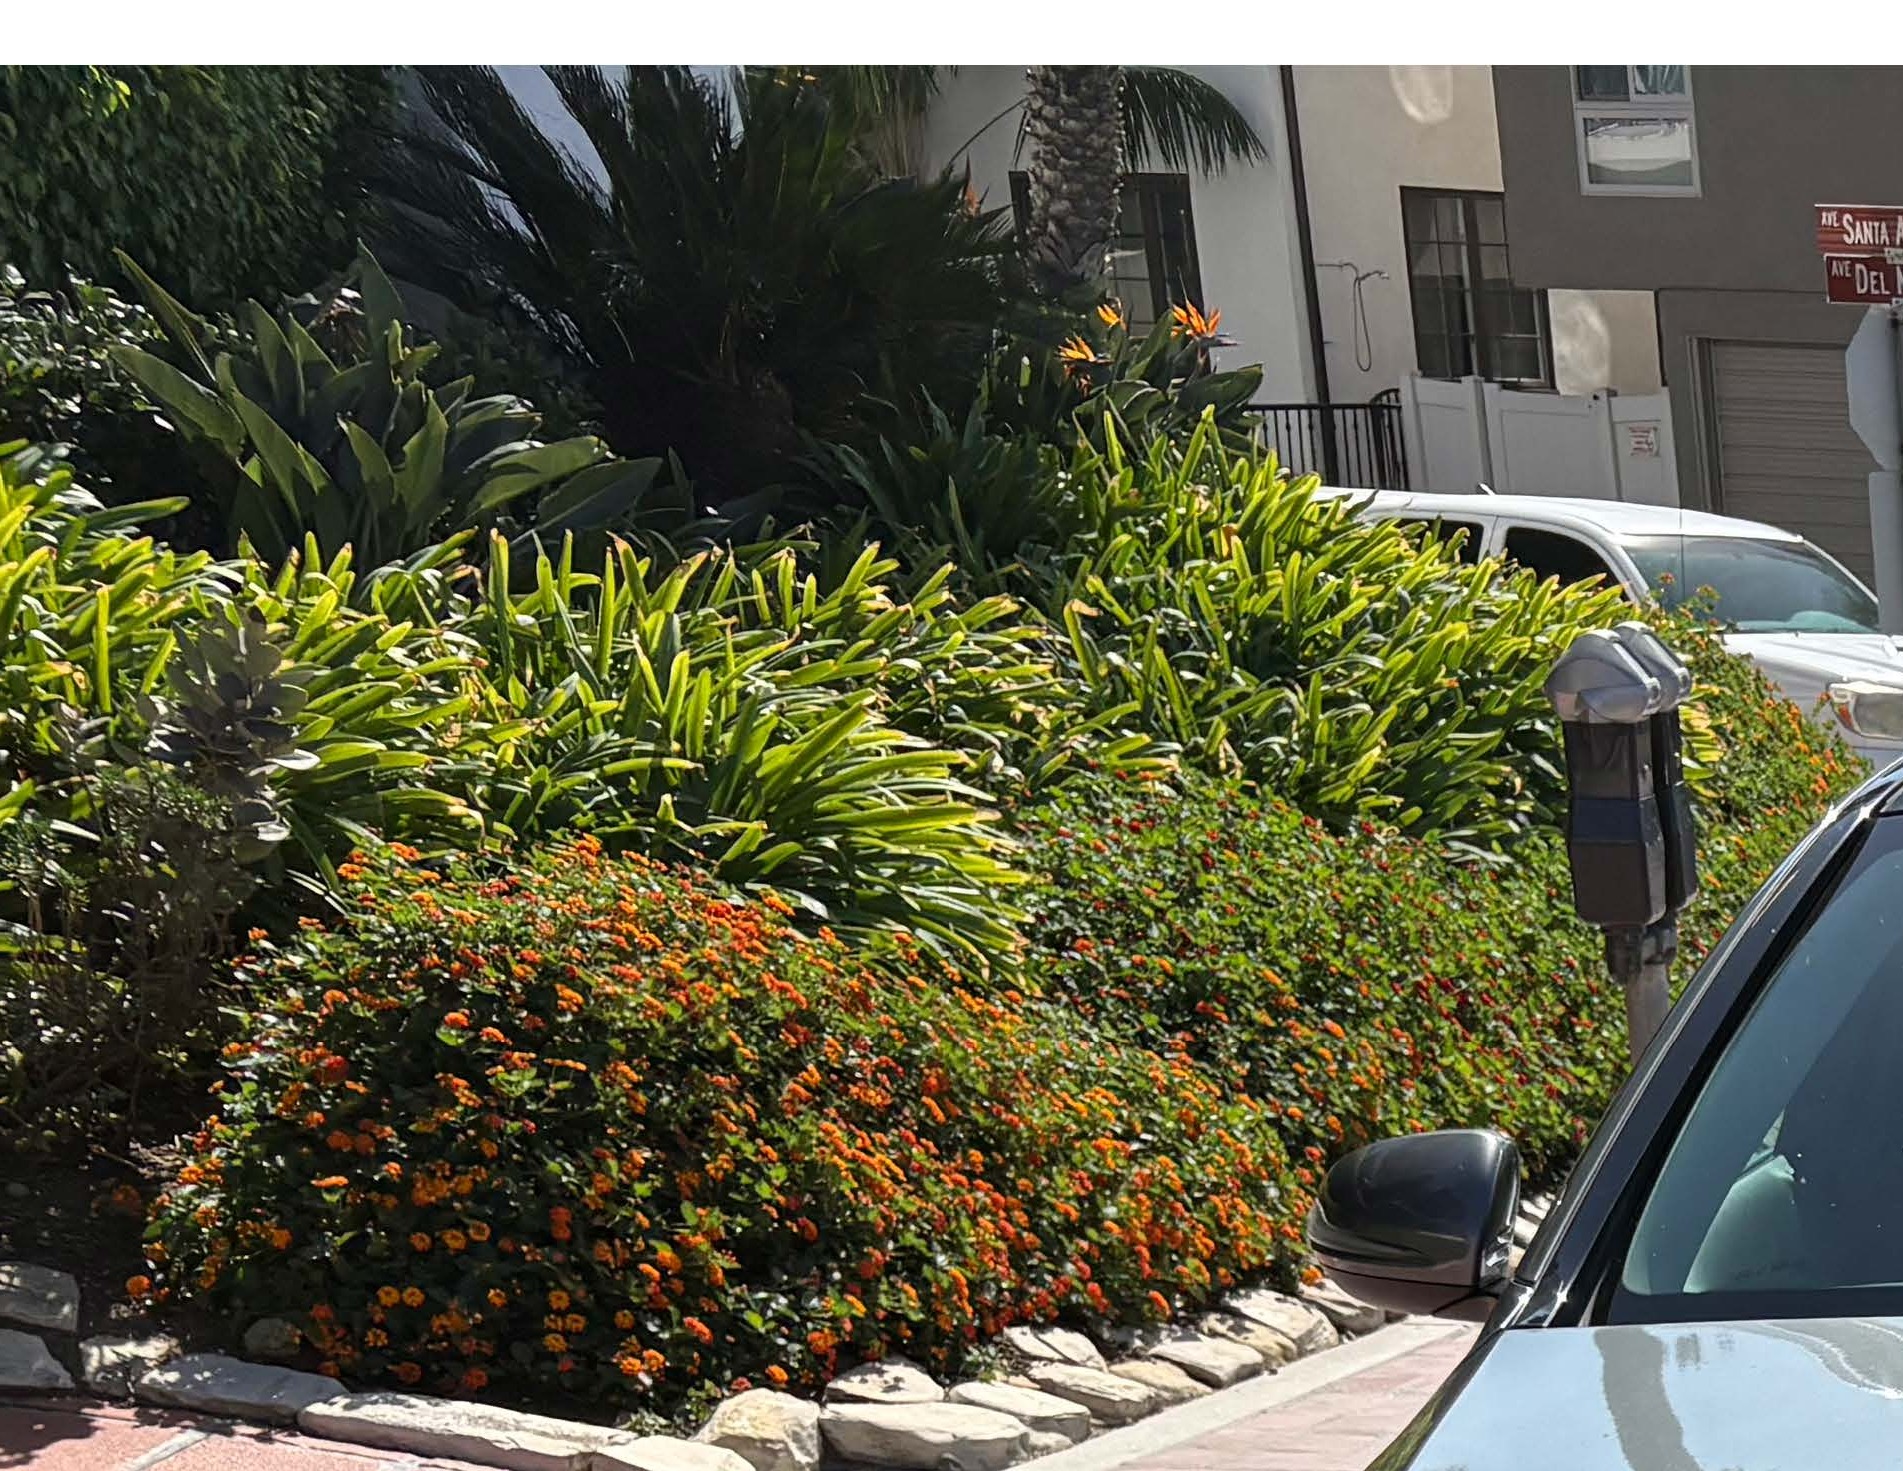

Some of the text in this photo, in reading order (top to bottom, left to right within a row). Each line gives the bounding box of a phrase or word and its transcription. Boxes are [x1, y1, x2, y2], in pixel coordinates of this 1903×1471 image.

[1821, 211, 1840, 228] AVE
[1842, 213, 1890, 246] SANTA
[1831, 259, 1852, 278] AVE
[1855, 263, 1891, 295] DEL
